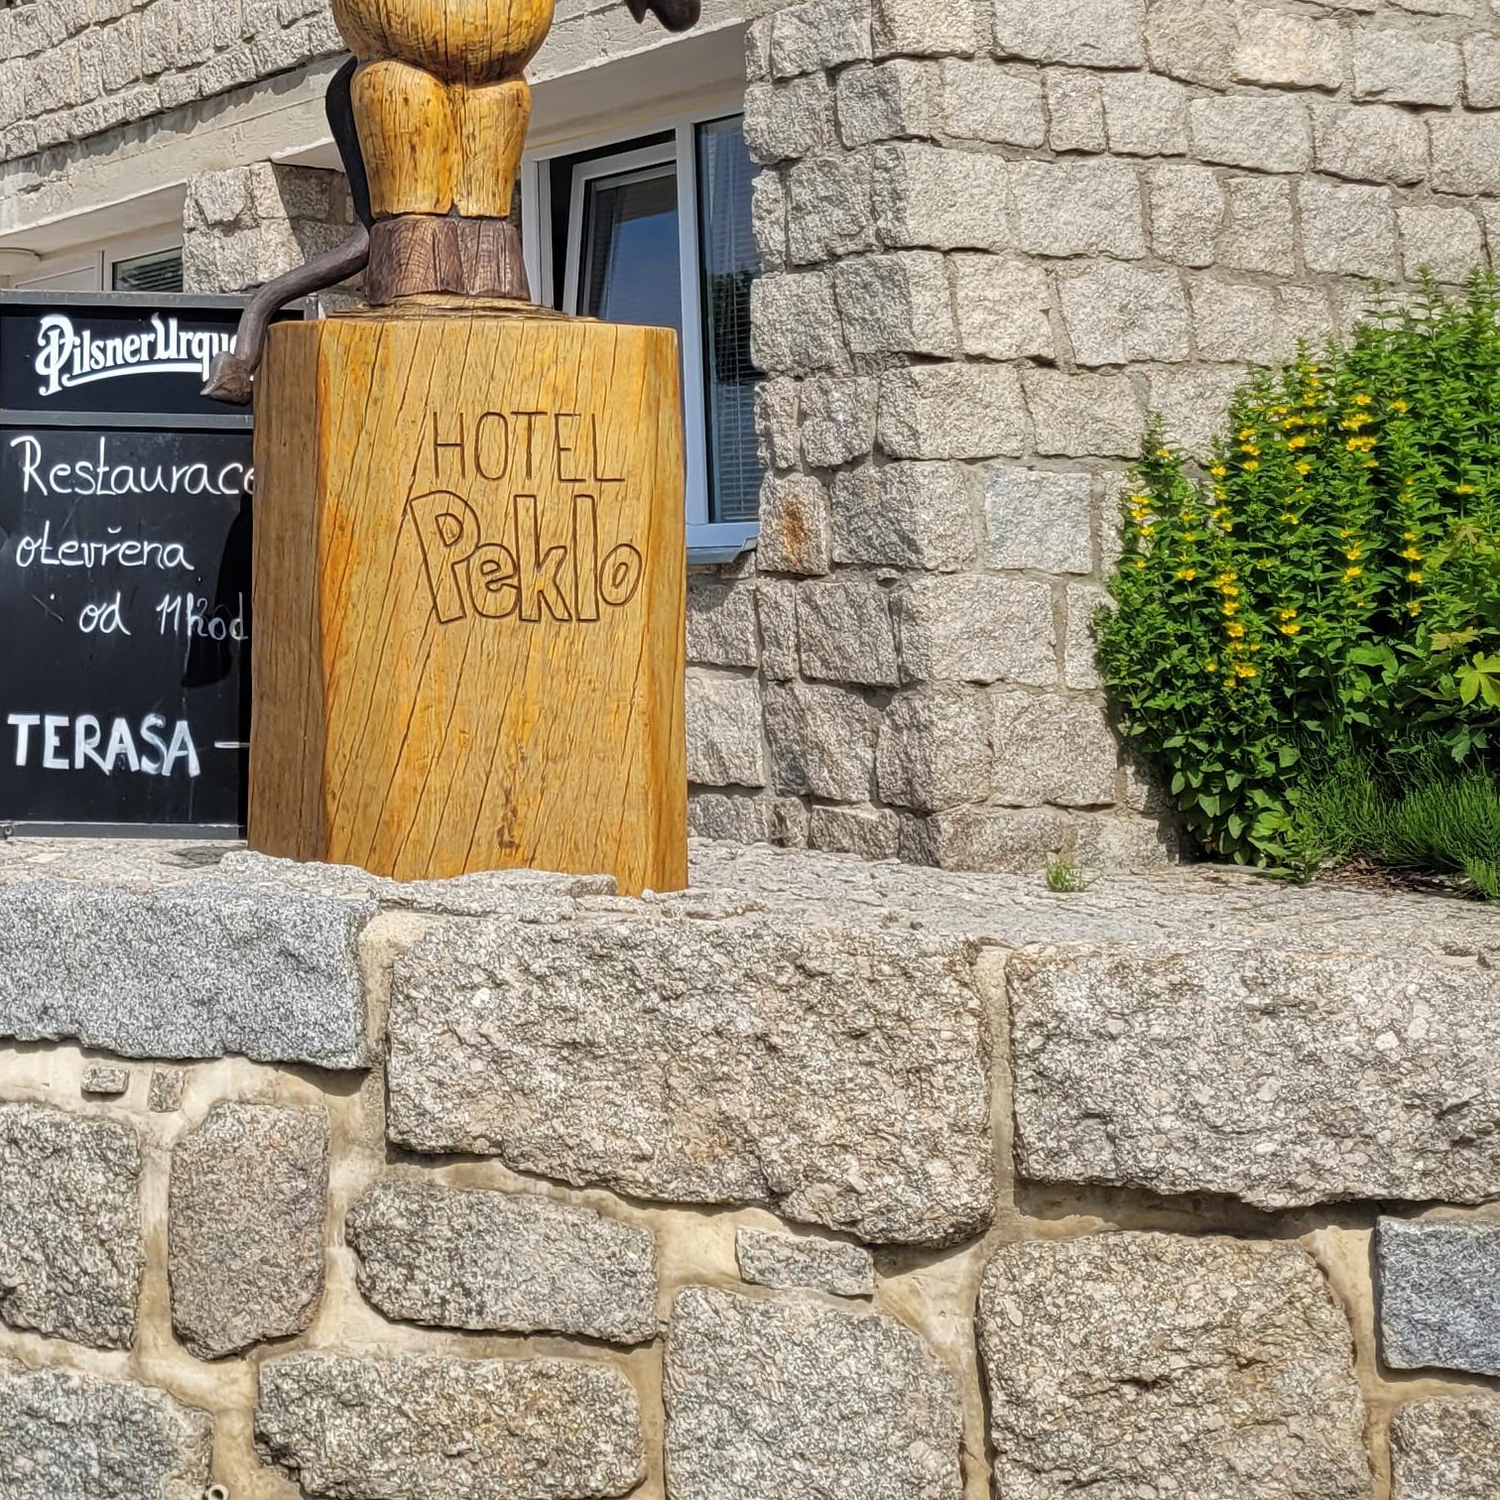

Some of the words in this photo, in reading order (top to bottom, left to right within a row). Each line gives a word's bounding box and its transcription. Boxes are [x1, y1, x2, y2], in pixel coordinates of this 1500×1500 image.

[35, 314, 155, 396] Pilsner
[432, 410, 626, 483] HOTEL
[15, 520, 195, 571] otevřena
[408, 490, 643, 625] Peklo
[78, 592, 132, 636] od
[7, 713, 200, 778] TERASA
